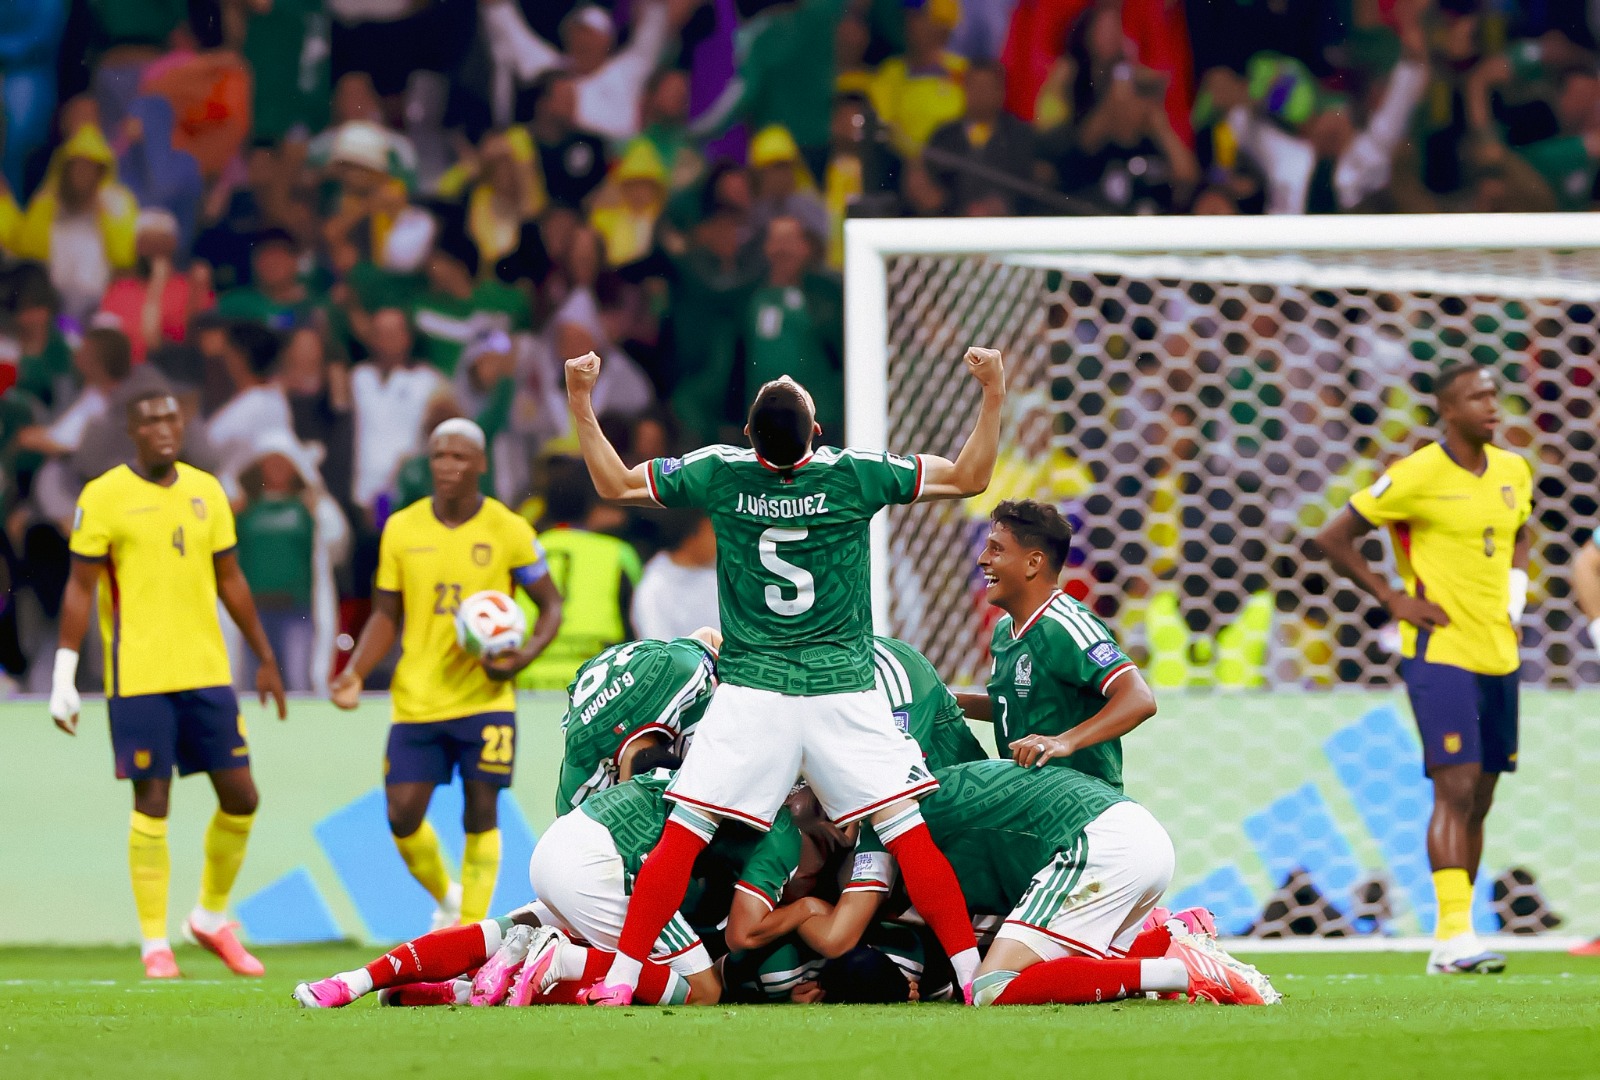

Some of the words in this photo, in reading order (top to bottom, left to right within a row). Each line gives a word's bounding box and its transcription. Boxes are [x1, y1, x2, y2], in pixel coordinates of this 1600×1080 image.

[735, 492, 829, 519] J.VÁSQUEZ
[172, 525, 186, 557] 4
[758, 526, 816, 617] 5
[434, 583, 462, 616] 23
[580, 671, 636, 726] G.MORA
[998, 695, 1008, 738] 7
[481, 724, 514, 764] 23
